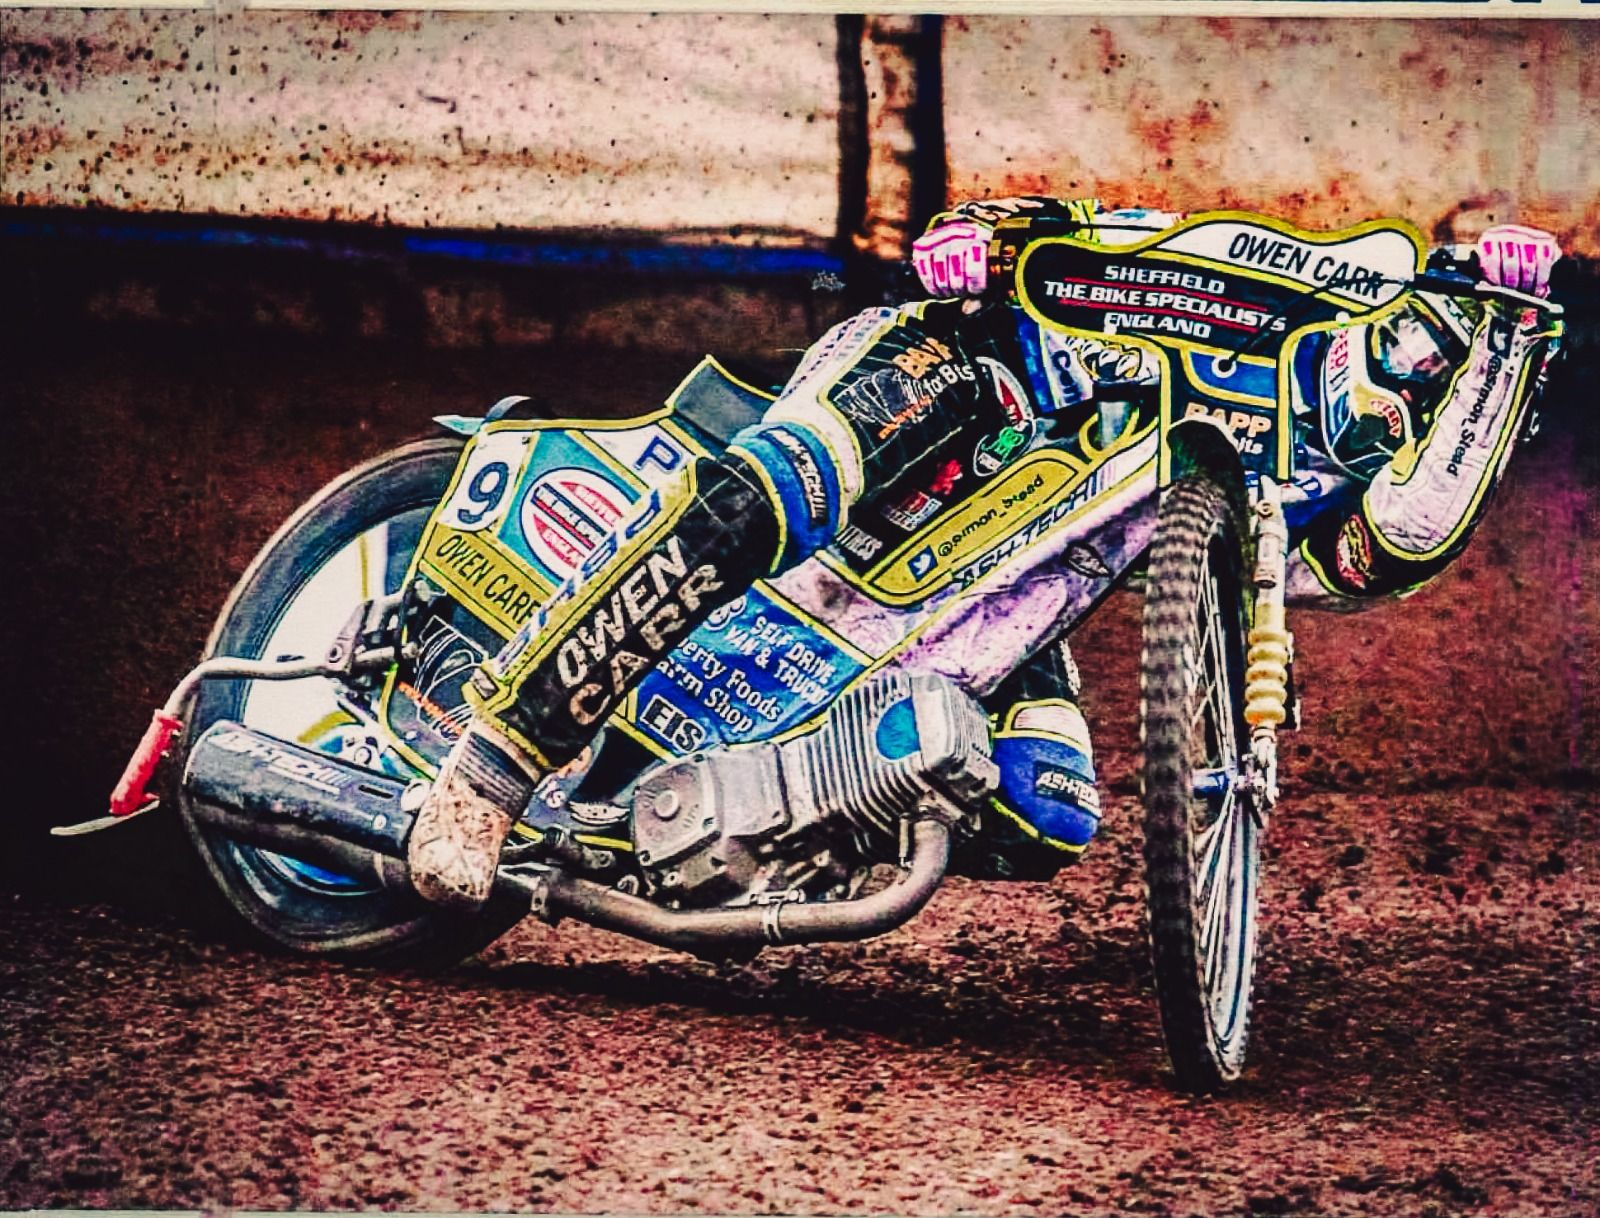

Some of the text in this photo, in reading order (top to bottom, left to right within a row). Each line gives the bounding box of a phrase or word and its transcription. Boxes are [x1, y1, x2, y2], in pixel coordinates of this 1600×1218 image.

[1105, 265, 1225, 294] SHEFFIELD
[1229, 233, 1384, 299] OWEN CARR
[1044, 280, 1287, 332] THE BIKE SPECIALISTS
[1104, 312, 1211, 339] ENGLAND
[458, 461, 509, 524] 9
[436, 534, 493, 585] OWEN
[556, 535, 688, 688] OWEN
[569, 564, 724, 725] CARR
[724, 625, 829, 706] VAN & TRUCK
[750, 616, 836, 684] SELF DRIVE
[643, 698, 703, 750] EIS
[656, 657, 753, 733] arm Shop
[726, 668, 783, 722] Foods
